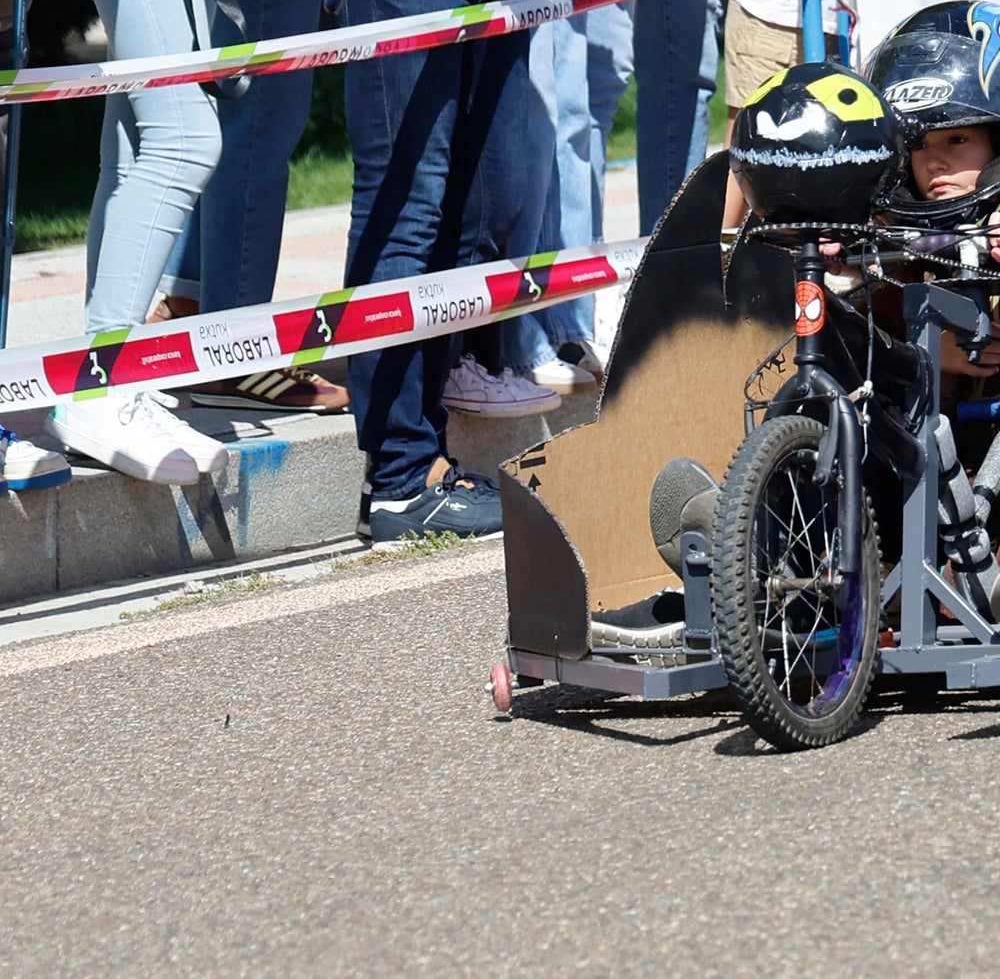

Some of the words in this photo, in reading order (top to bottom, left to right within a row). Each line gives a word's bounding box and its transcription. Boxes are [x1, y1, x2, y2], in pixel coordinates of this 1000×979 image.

[888, 86, 950, 103] LAZER
[418, 282, 446, 300] kutxa
[422, 296, 485, 327] LABORAL
[199, 322, 230, 340] kutxa
[203, 336, 273, 367] LABORAL
[0, 378, 47, 404] LABO
